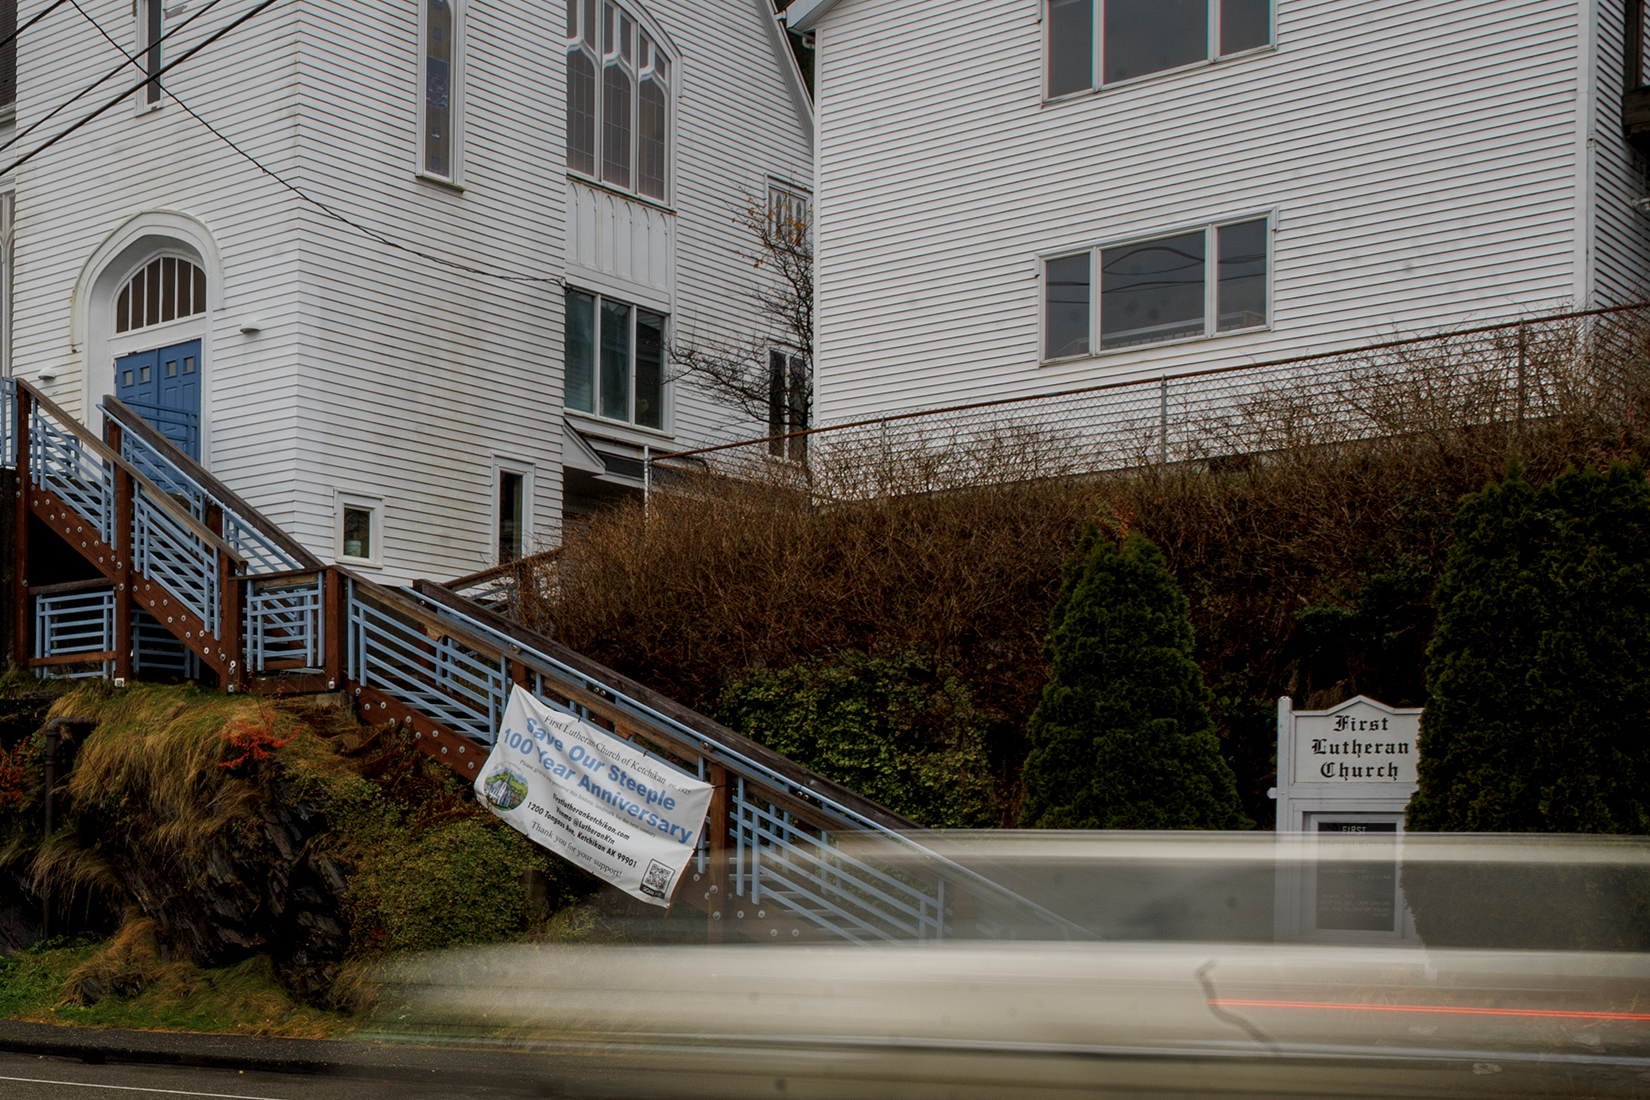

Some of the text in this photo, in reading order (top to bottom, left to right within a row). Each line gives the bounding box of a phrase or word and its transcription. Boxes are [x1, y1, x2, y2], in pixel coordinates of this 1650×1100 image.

[1332, 715, 1389, 731] First
[527, 717, 676, 810] Save Our Steeple
[544, 715, 563, 730] First
[563, 725, 596, 748] Lutheran
[595, 742, 623, 761] Church
[621, 757, 631, 767] of
[631, 760, 666, 784] Ketchikan
[677, 787, 691, 796] 1925
[1311, 739, 1409, 758] Lutheran
[504, 728, 693, 844] 100 Year Anniversary
[1320, 762, 1399, 781] Church
[556, 805, 572, 822] Venmo
[1342, 826, 1367, 835] FIRST
[527, 801, 637, 868] 1200 Tongass Ave, Ketchikan AK 99901
[531, 820, 623, 878] Thank you for your support!
